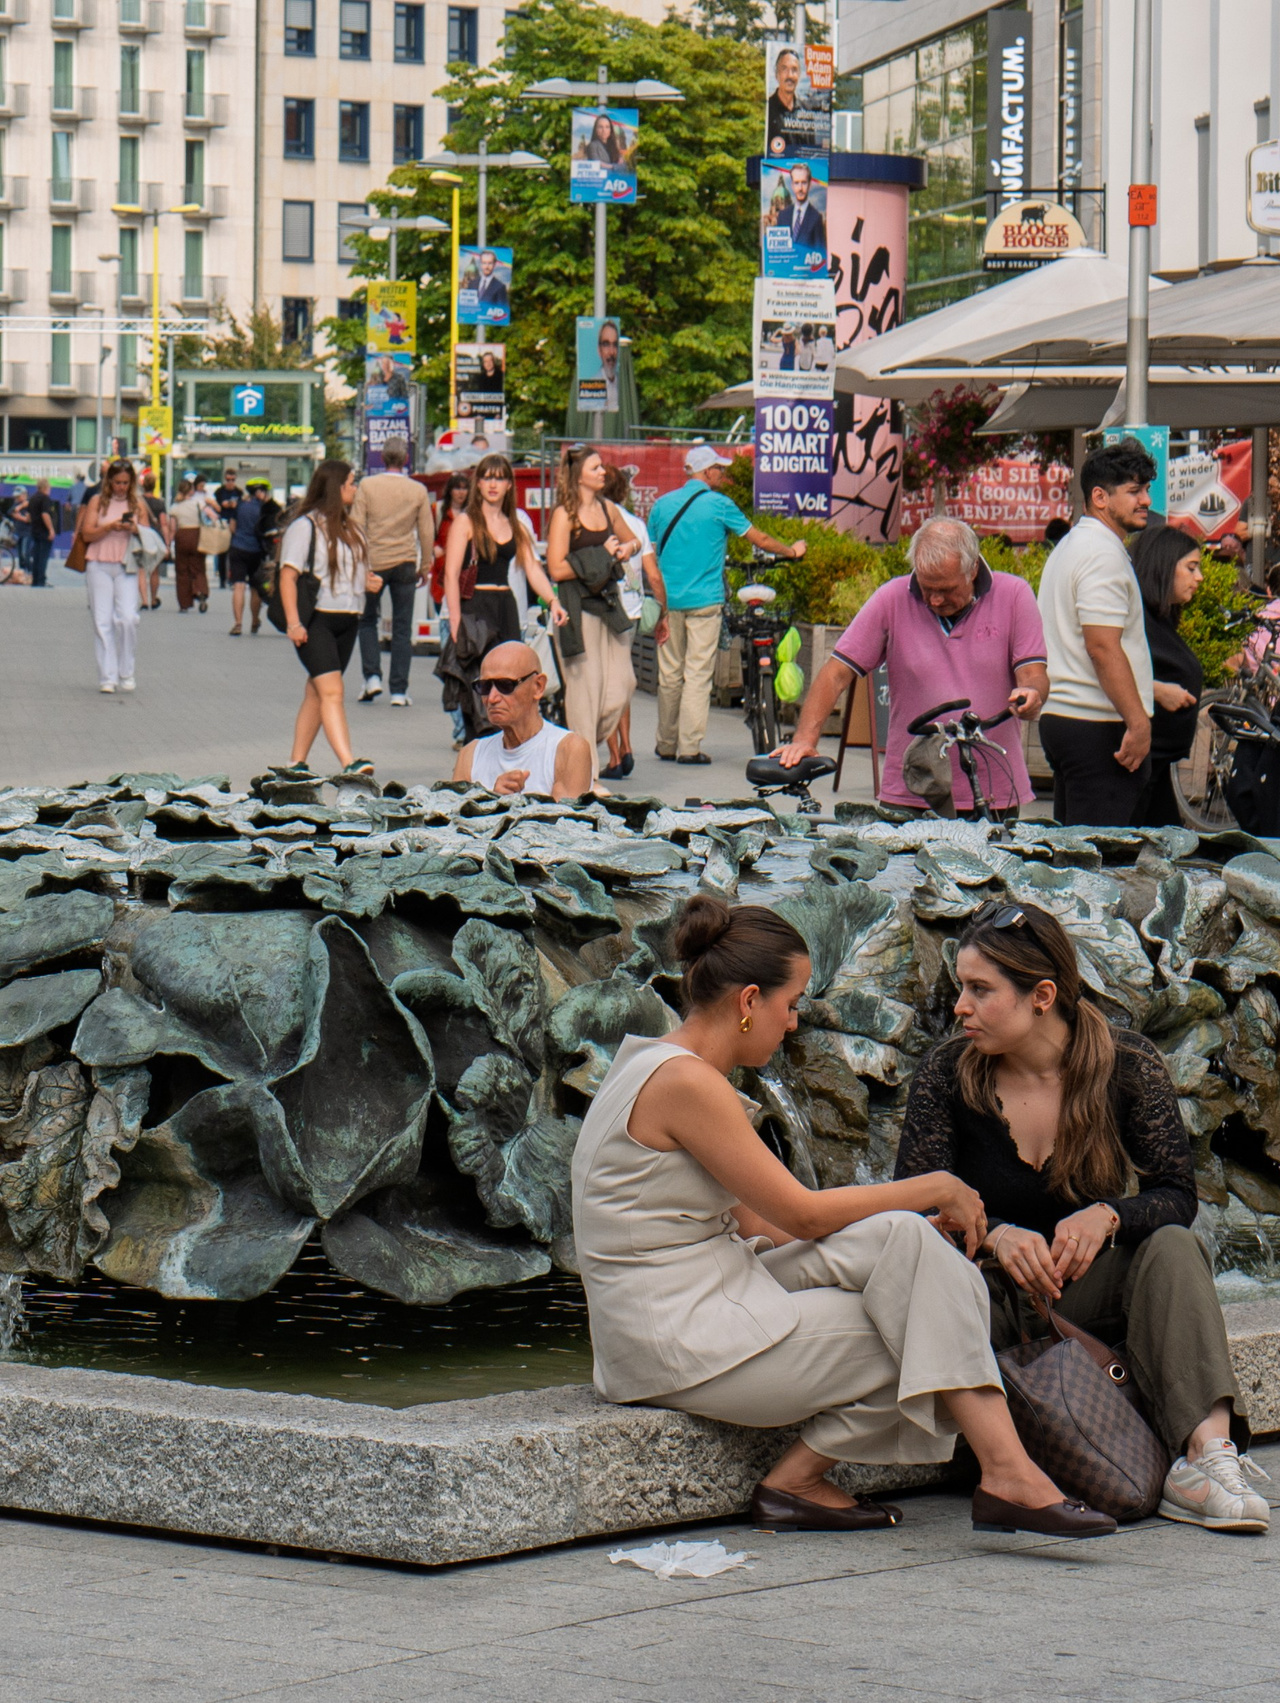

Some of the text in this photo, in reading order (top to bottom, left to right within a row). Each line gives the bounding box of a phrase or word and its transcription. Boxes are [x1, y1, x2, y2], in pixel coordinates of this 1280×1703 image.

[807, 47, 832, 62] Bruno
[807, 62, 832, 73] Adam
[813, 73, 831, 87] Wolf
[604, 180, 628, 191] AfD
[1003, 224, 1069, 236] BLOCK
[1003, 236, 1069, 248] HOUSE
[804, 252, 823, 265] AfD
[987, 260, 1006, 269] BEST
[1008, 260, 1039, 268] STEAKS
[767, 298, 798, 307] Frauen
[486, 307, 505, 316] AfD
[773, 309, 832, 319] kein Freiwild!
[760, 380, 829, 391] Die Hannoveraner
[243, 397, 257, 414] P
[369, 418, 408, 430] BEZAHL
[760, 404, 830, 432] 100%
[759, 431, 830, 454] SMART
[1009, 467, 1040, 483] SIE
[1180, 464, 1214, 475] wieder
[1179, 479, 1195, 489] Sie
[975, 484, 1042, 504] (800M)
[1169, 492, 1186, 502] da!
[794, 492, 828, 511] Volt
